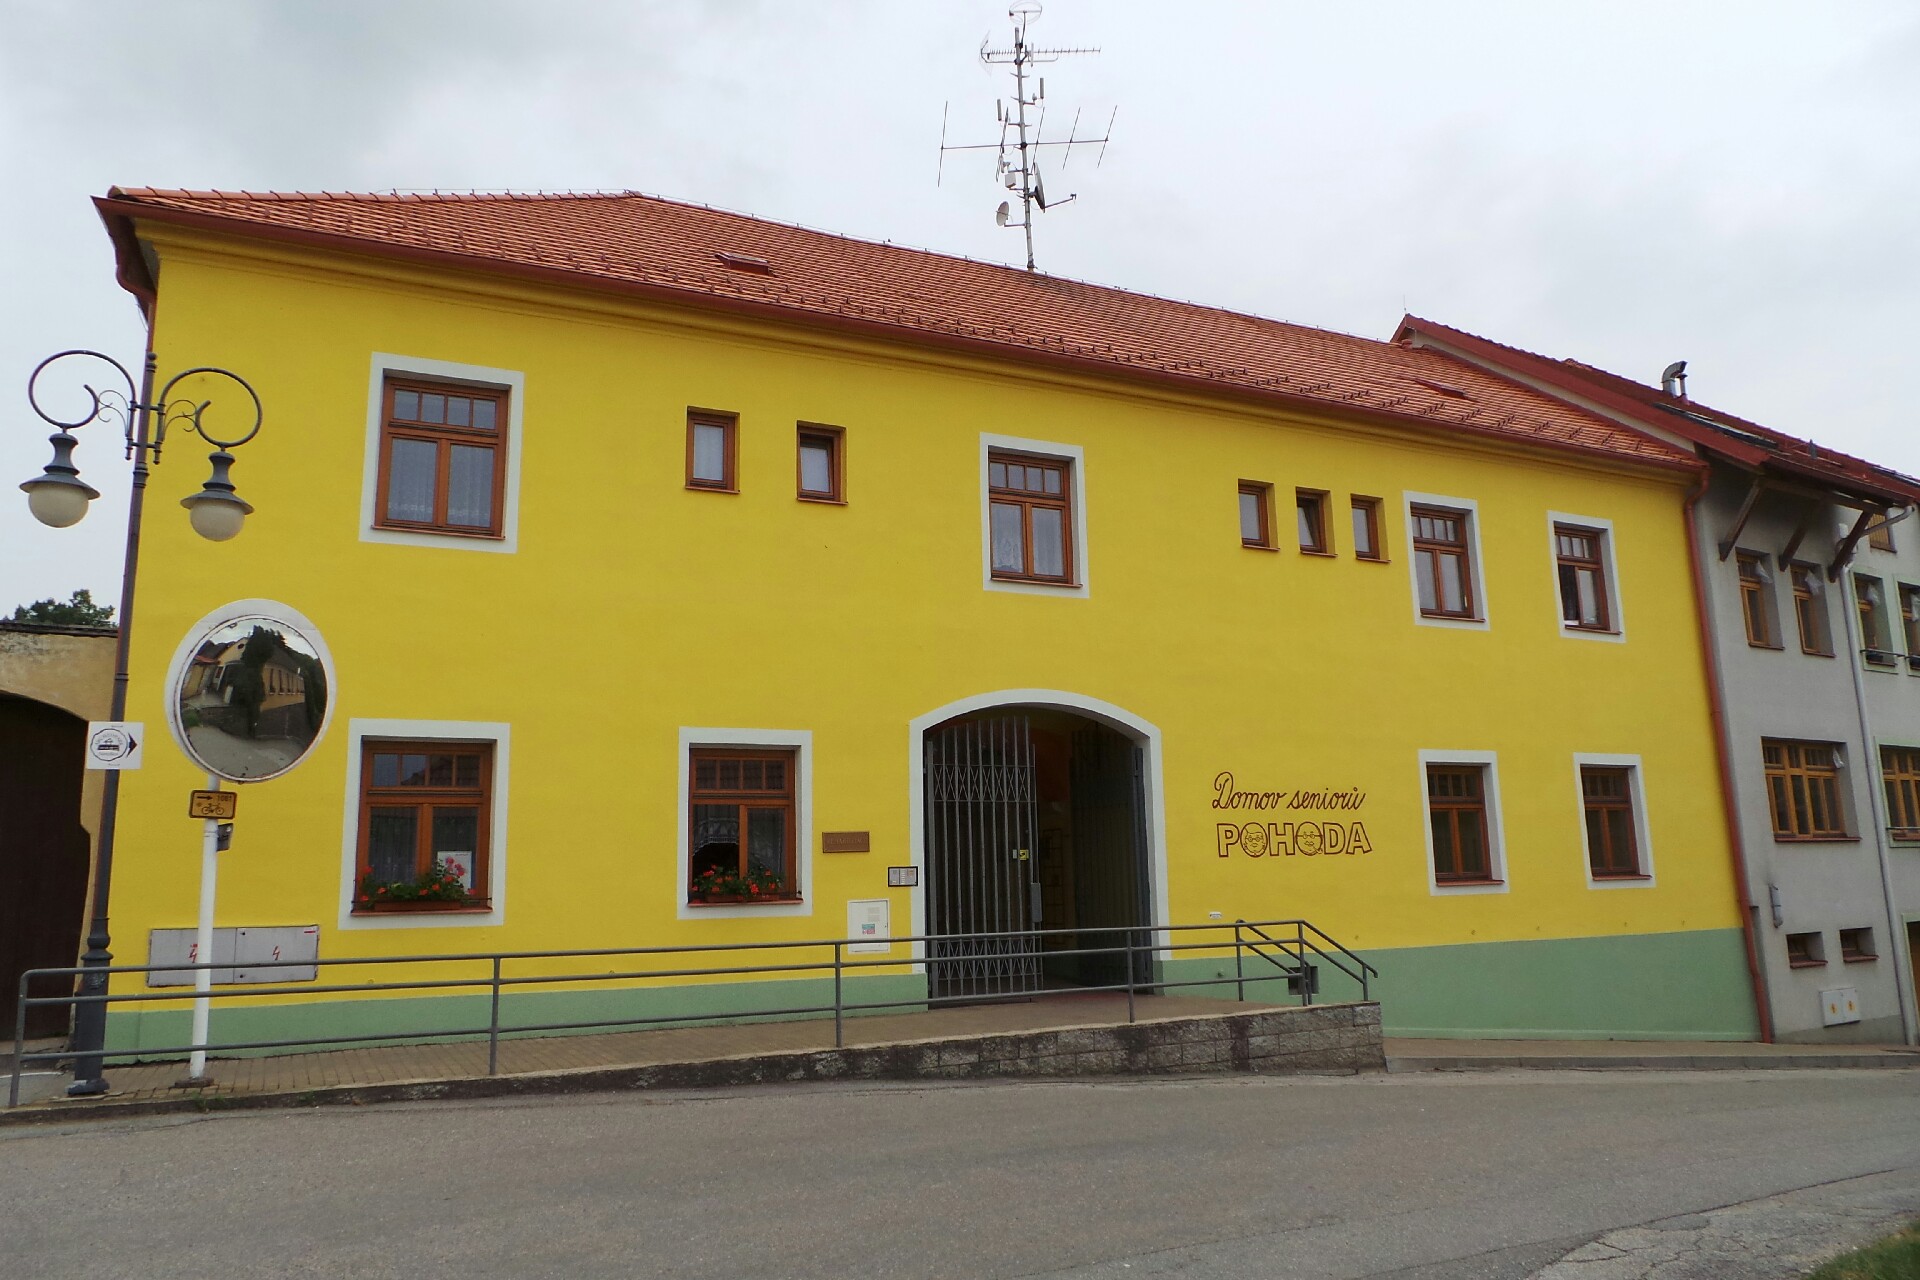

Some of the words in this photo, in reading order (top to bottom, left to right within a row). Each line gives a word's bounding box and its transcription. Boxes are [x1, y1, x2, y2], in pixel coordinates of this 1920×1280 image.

[1211, 771, 1287, 810] Domov
[1287, 787, 1366, 810] seniorů
[1216, 821, 1373, 858] POHODA
